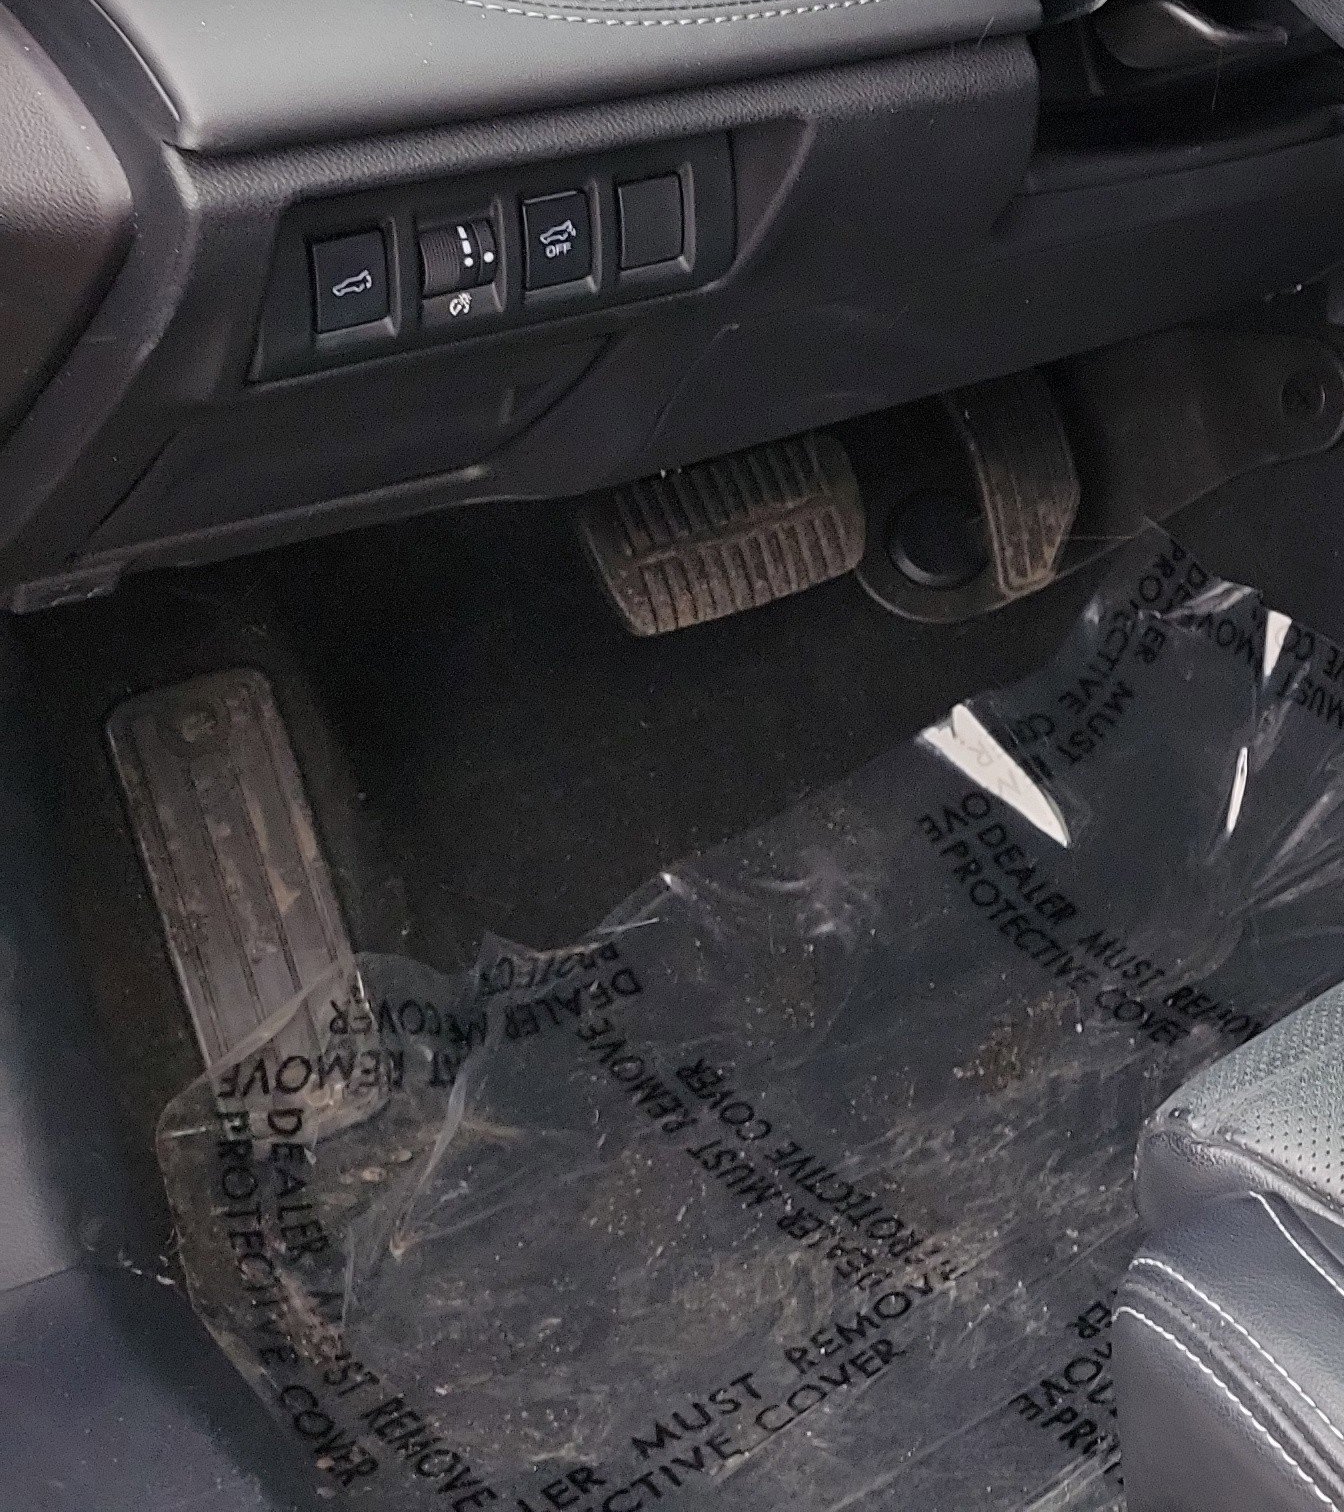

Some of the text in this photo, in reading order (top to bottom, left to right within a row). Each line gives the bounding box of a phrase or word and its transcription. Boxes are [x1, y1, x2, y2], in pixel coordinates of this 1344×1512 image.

[545, 241, 573, 259] OFF
[1057, 681, 1134, 766] MUST
[939, 840, 1099, 990] PROTECTIVE
[977, 823, 1078, 926] DEALER
[1079, 929, 1165, 988] MUST
[504, 966, 645, 1040] DEALER
[575, 1017, 699, 1134] REMOVE
[675, 1057, 773, 1140] COVER
[685, 1138, 785, 1207] MUST
[266, 1108, 330, 1265] DEALER
[359, 1396, 499, 1512] REMOVE
[630, 1370, 763, 1460] MUST
[754, 1337, 907, 1437] COVER
